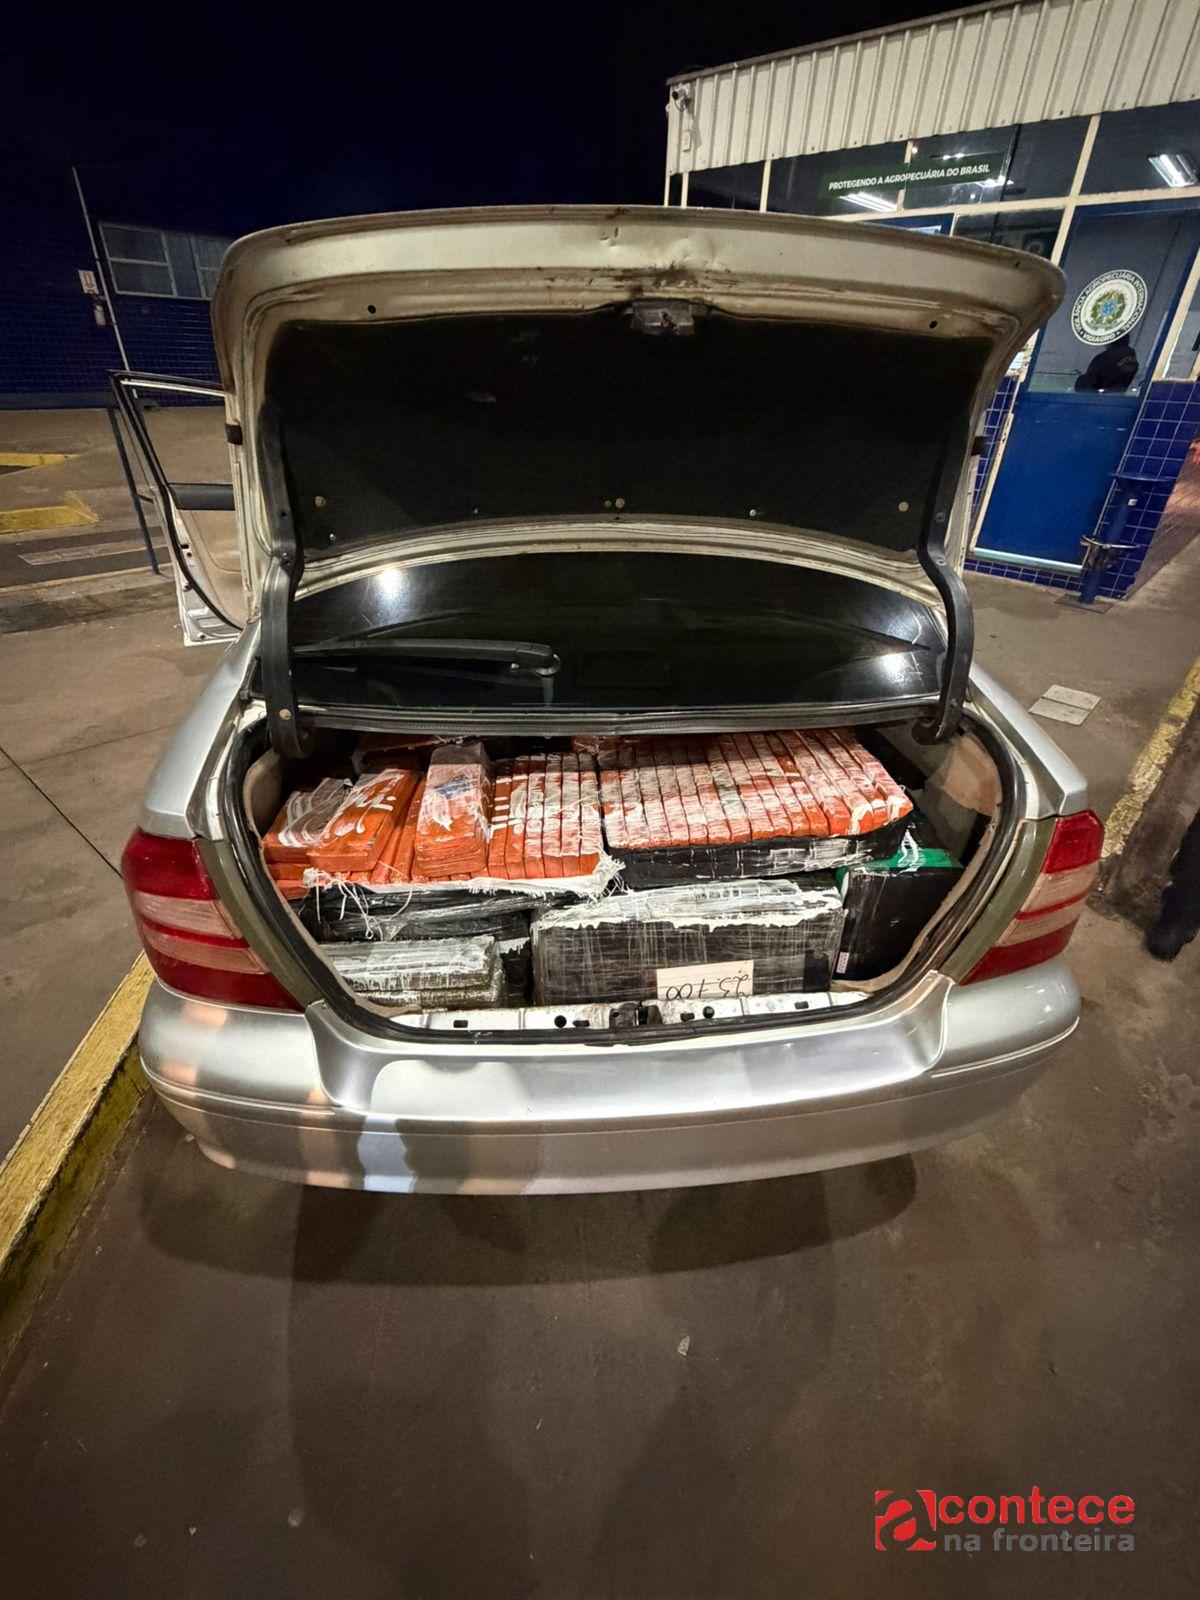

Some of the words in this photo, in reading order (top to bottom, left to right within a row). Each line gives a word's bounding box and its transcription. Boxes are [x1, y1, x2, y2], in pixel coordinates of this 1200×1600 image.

[828, 178, 877, 191] PROTEGENDO
[877, 176, 884, 185] A
[884, 168, 945, 184] AGROPECUÁRIA
[946, 168, 959, 177] DO
[960, 163, 990, 175] BRASIL
[1083, 332, 1116, 343] VIGIAGRO
